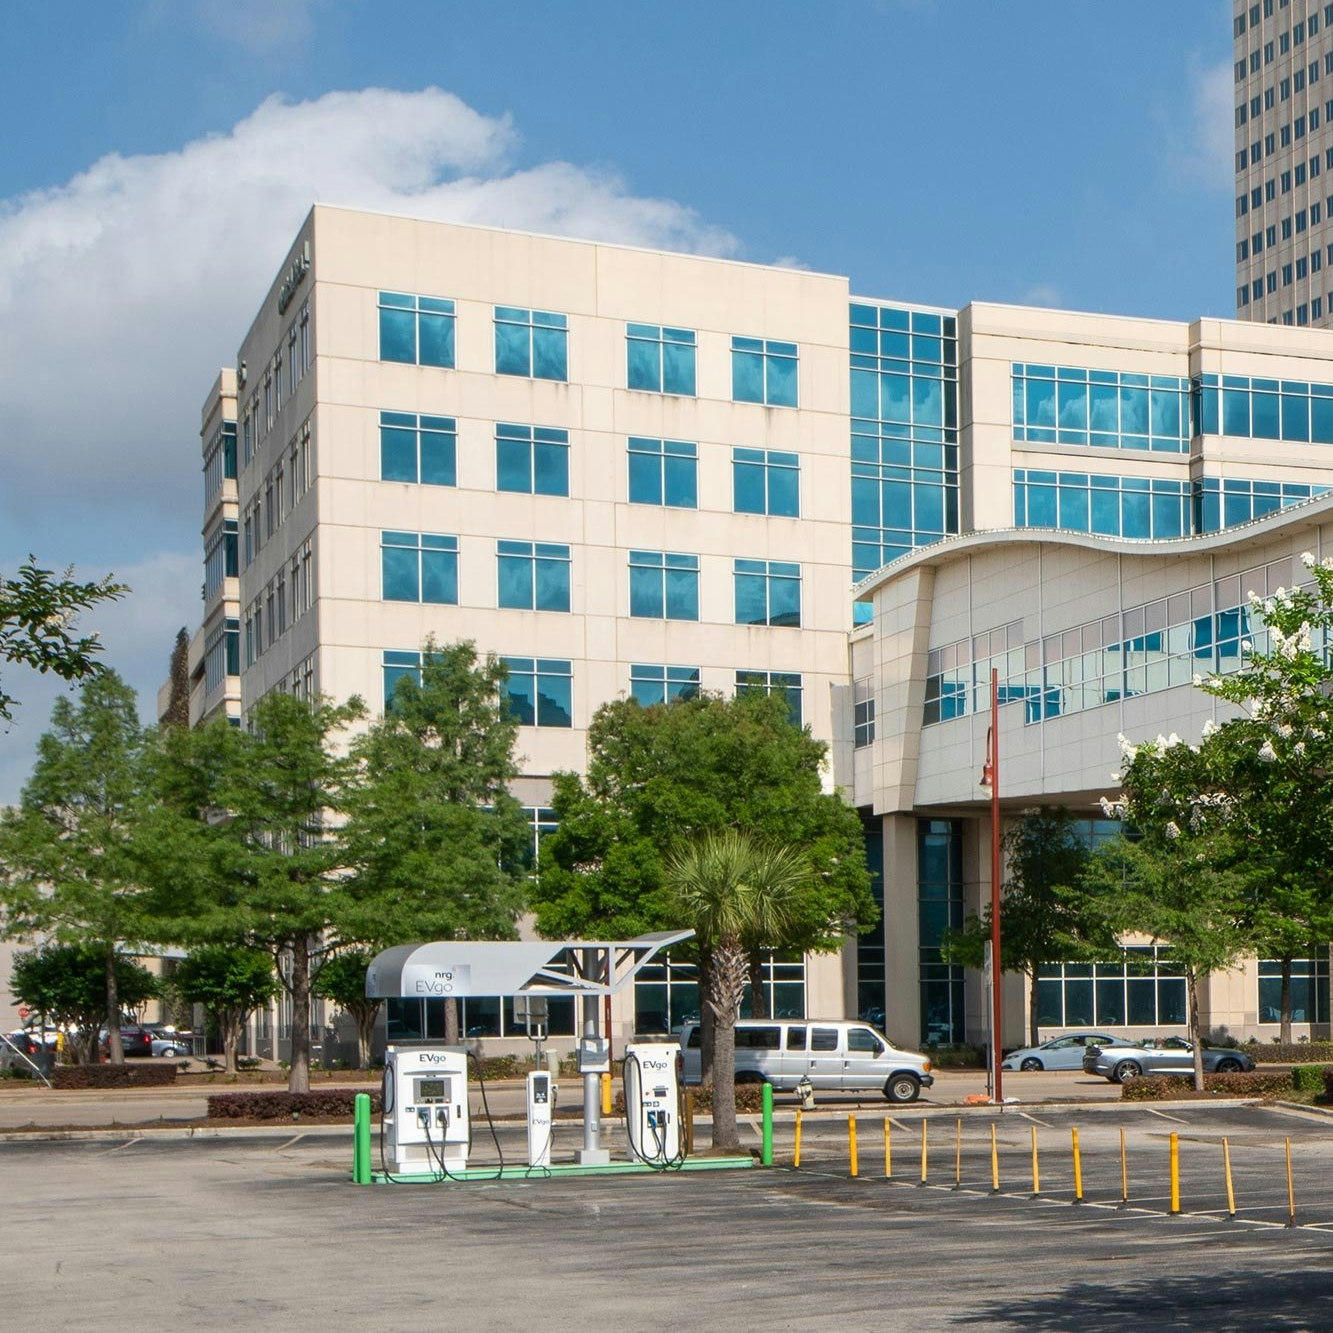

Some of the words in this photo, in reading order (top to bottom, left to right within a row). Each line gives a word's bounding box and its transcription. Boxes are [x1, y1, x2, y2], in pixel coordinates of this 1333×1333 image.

[415, 980, 453, 996] EVgo
[419, 1054, 446, 1064] EVgo
[643, 1061, 668, 1070] EVgo
